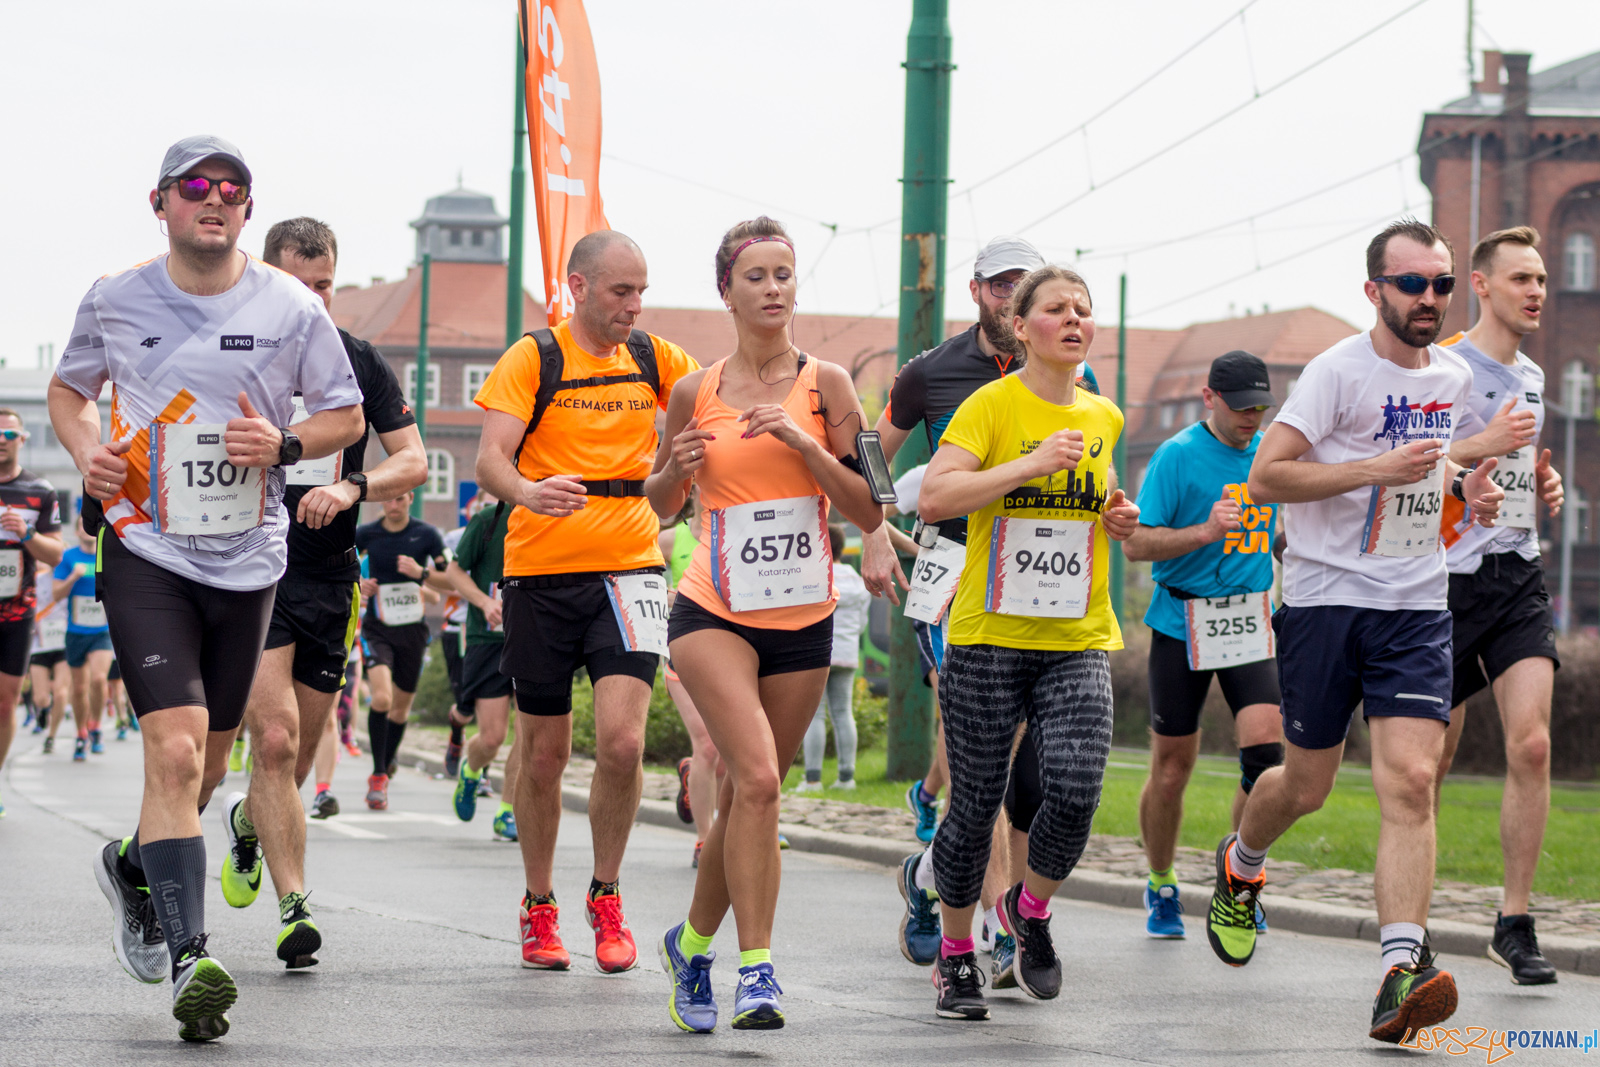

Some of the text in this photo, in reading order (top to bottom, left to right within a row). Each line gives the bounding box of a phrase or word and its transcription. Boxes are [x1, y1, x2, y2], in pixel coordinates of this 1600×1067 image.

[140, 337, 162, 348] 4F
[235, 339, 252, 347] PKO
[628, 399, 654, 410] TEAM
[1424, 411, 1452, 429] BIEG
[206, 435, 218, 443] PKO
[199, 492, 238, 503] Sławomir
[1395, 490, 1441, 517] 11436
[1037, 510, 1085, 518] WARSAW
[740, 531, 813, 565] 6578
[1223, 531, 1270, 555] FUN
[1015, 549, 1082, 577] 9406
[758, 566, 802, 577] Katarzyna
[1038, 581, 1061, 589] Beata
[384, 595, 419, 608] 11428
[1205, 615, 1258, 638] 3255
